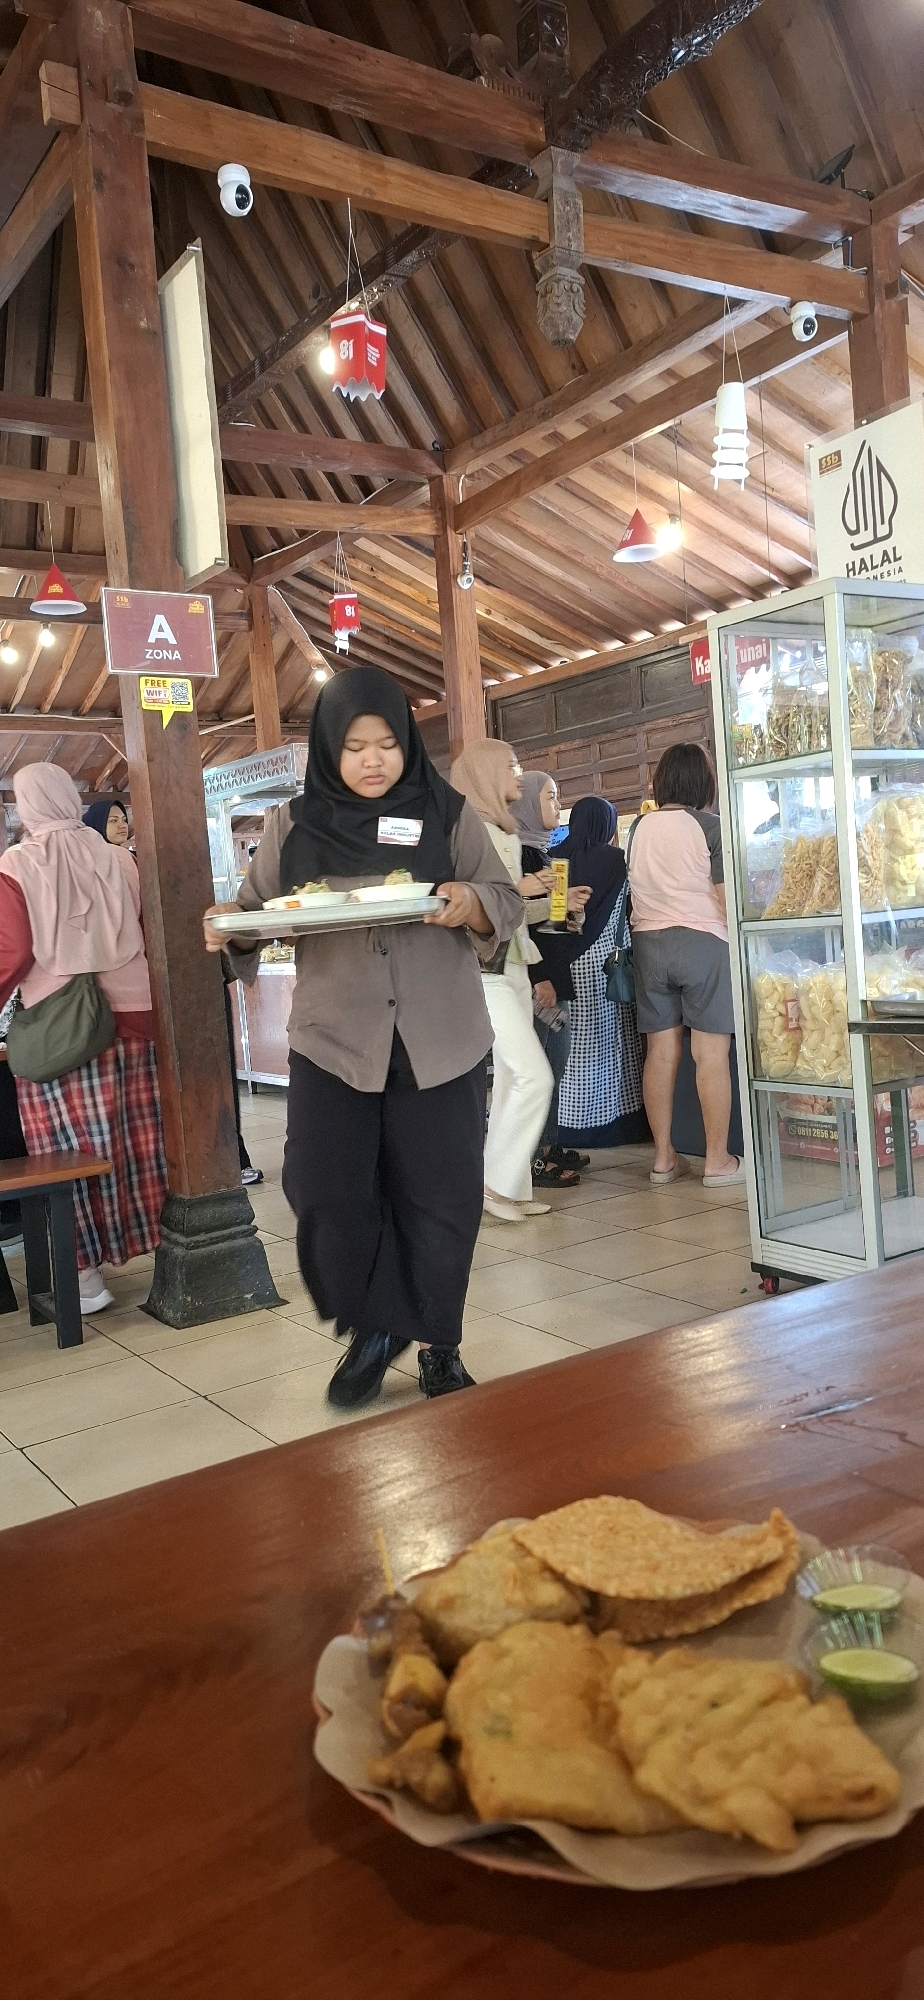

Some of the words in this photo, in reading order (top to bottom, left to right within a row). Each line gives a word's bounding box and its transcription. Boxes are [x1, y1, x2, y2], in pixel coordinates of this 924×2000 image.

[340, 339, 354, 360] 81
[846, 546, 902, 578] HALAL
[345, 605, 355, 617] 81
[147, 614, 177, 644] A
[145, 649, 182, 660] ZONA
[144, 679, 167, 687] FREE
